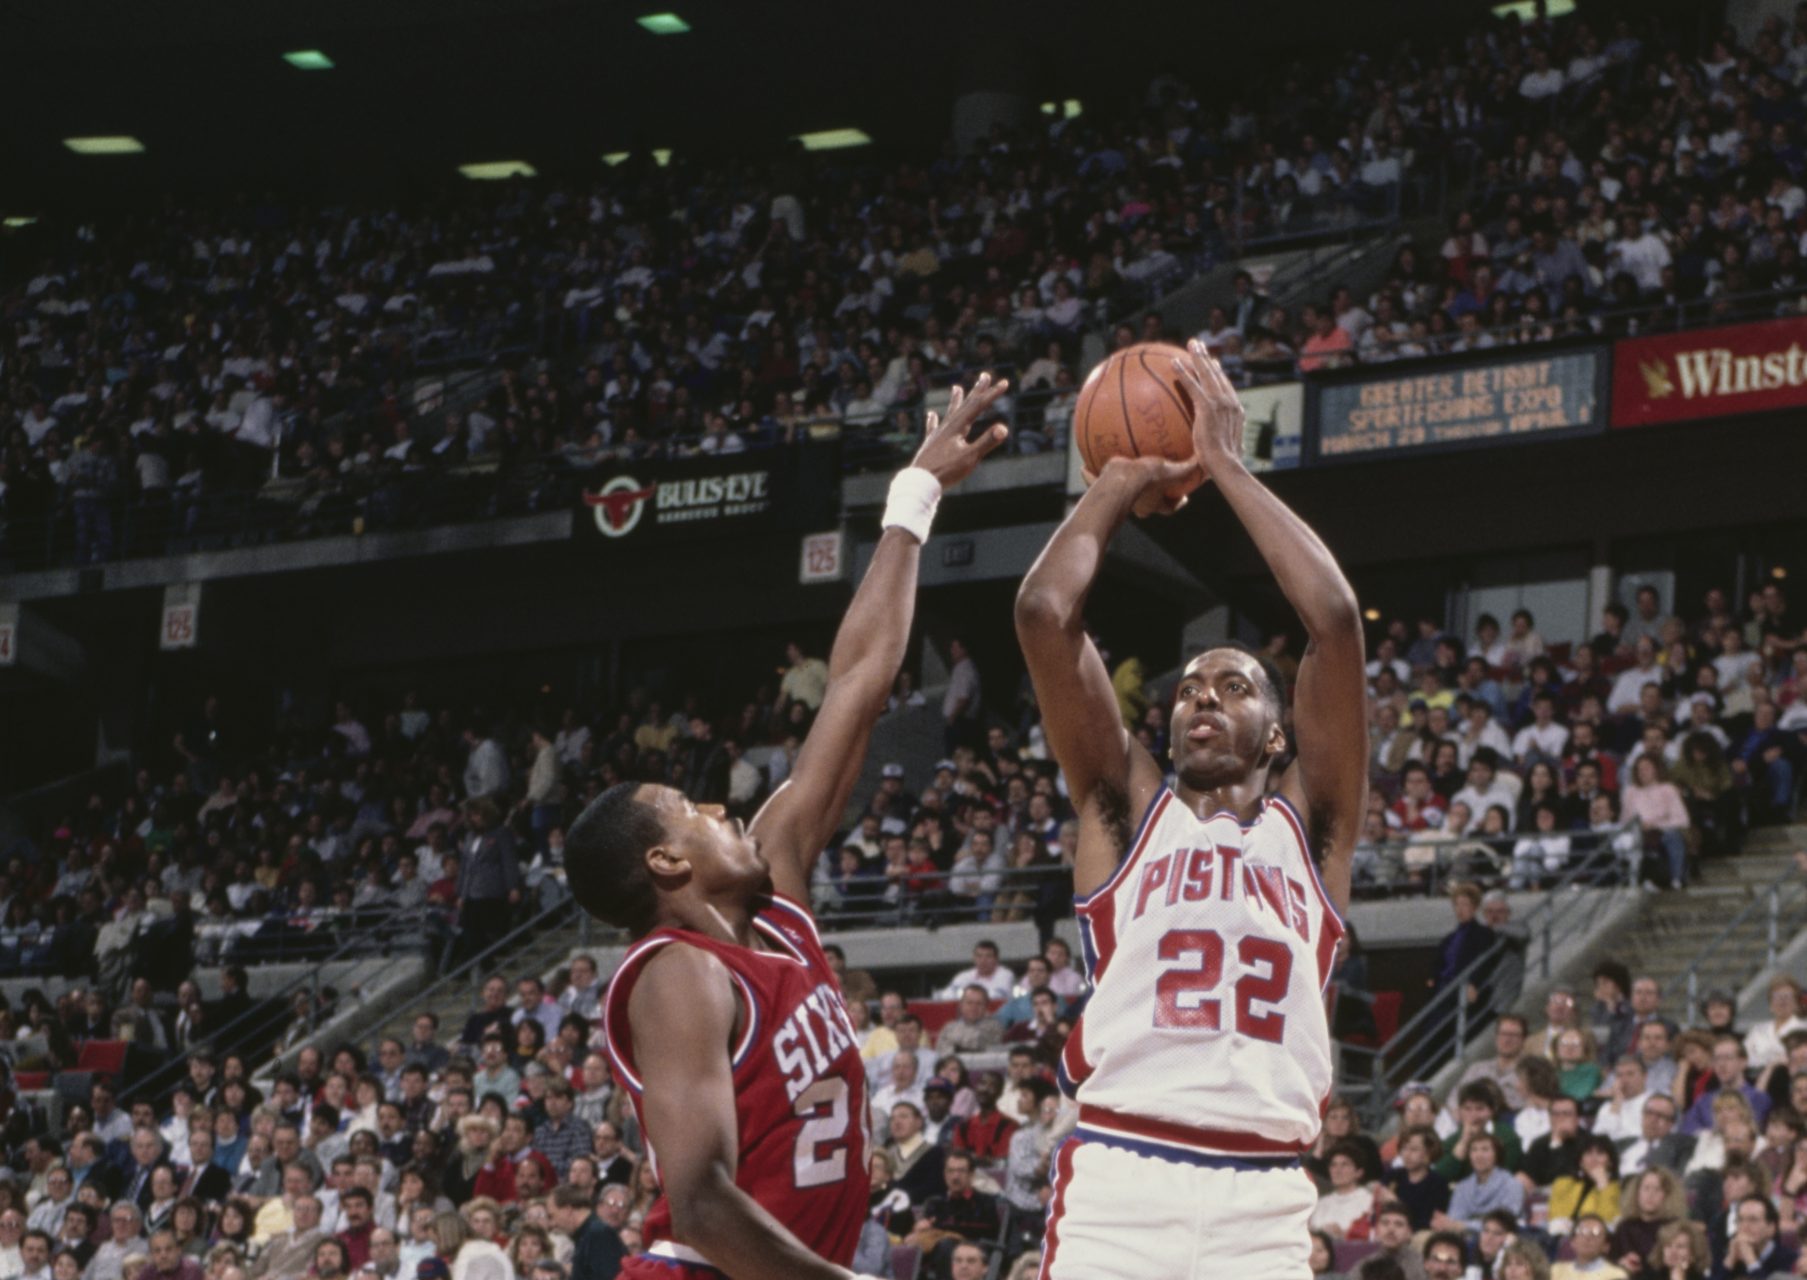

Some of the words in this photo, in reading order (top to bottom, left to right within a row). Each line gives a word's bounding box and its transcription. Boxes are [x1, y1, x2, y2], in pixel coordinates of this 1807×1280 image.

[1503, 385, 1562, 413] EXPO
[1675, 342, 1807, 399] Winst
[1133, 844, 1310, 944] PISTNS
[1152, 928, 1294, 1045] 22
[773, 984, 860, 1103] SIX
[794, 1075, 873, 1187] 2
